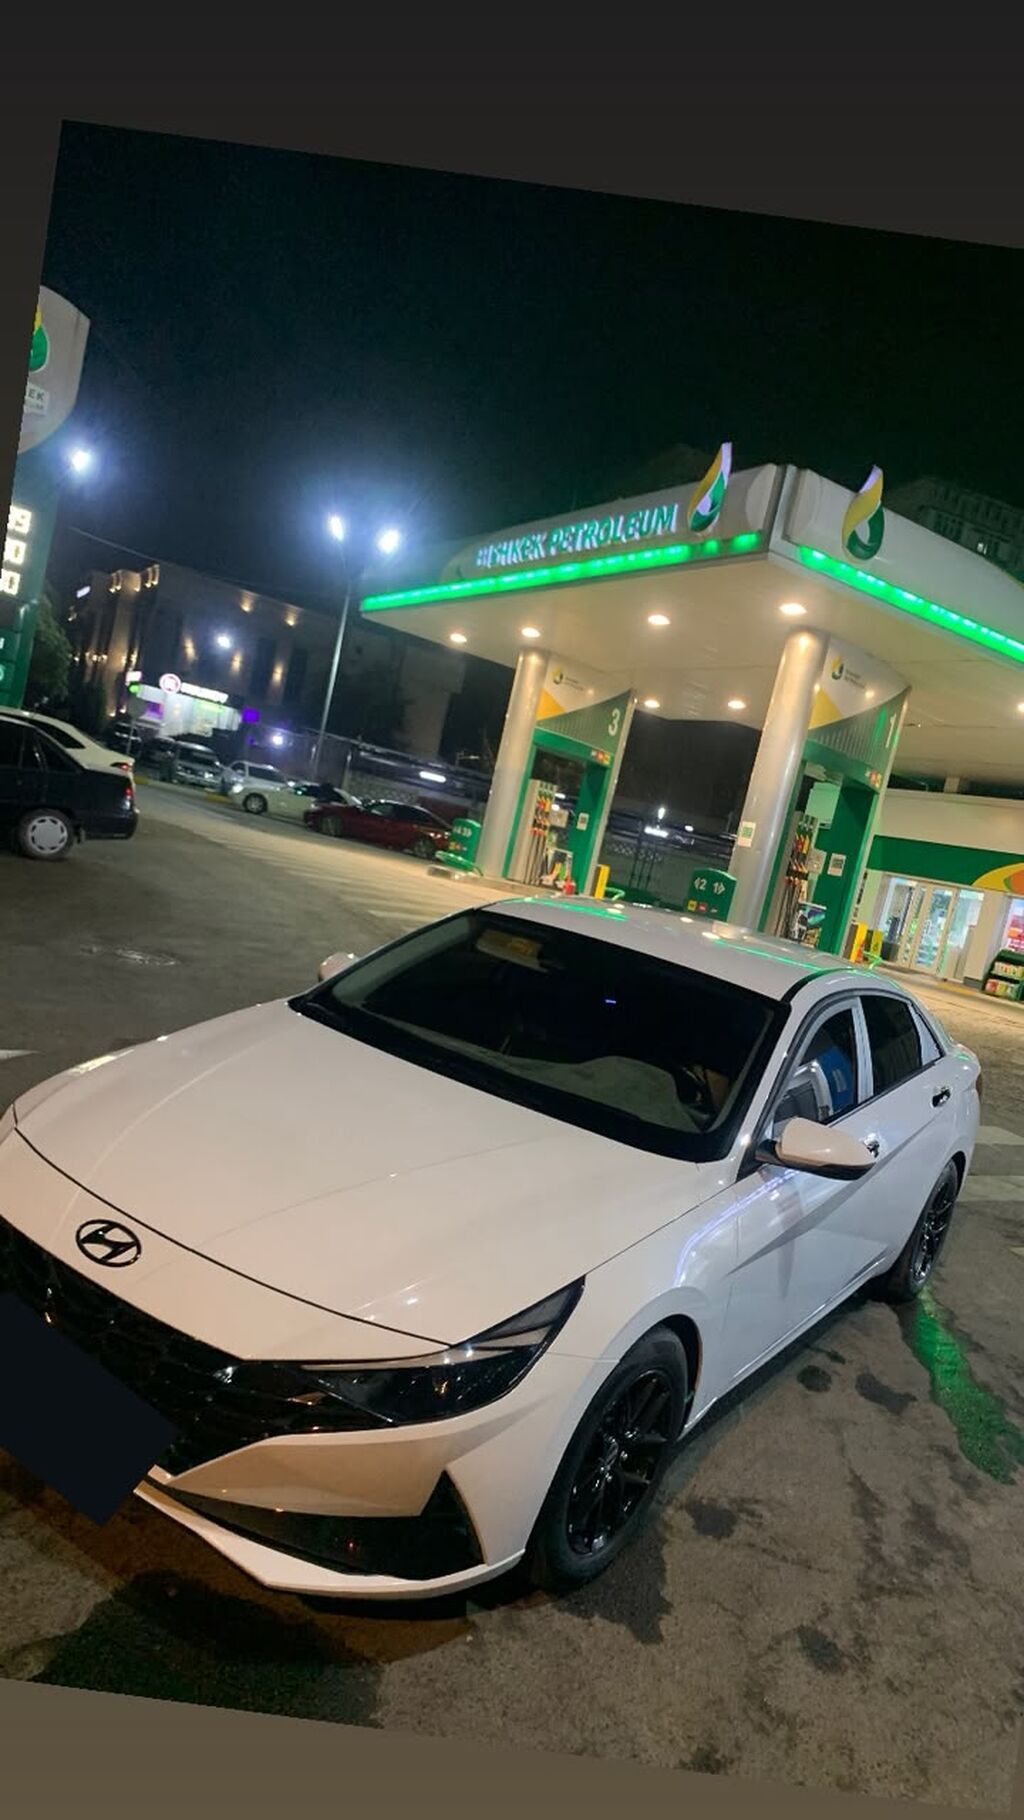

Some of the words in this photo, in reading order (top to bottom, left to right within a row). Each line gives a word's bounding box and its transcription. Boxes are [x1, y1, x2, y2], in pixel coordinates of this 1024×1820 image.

[548, 503, 679, 557] PETROLEUM
[608, 708, 621, 736] 3
[885, 712, 897, 748] 1
[699, 878, 708, 891] 2
